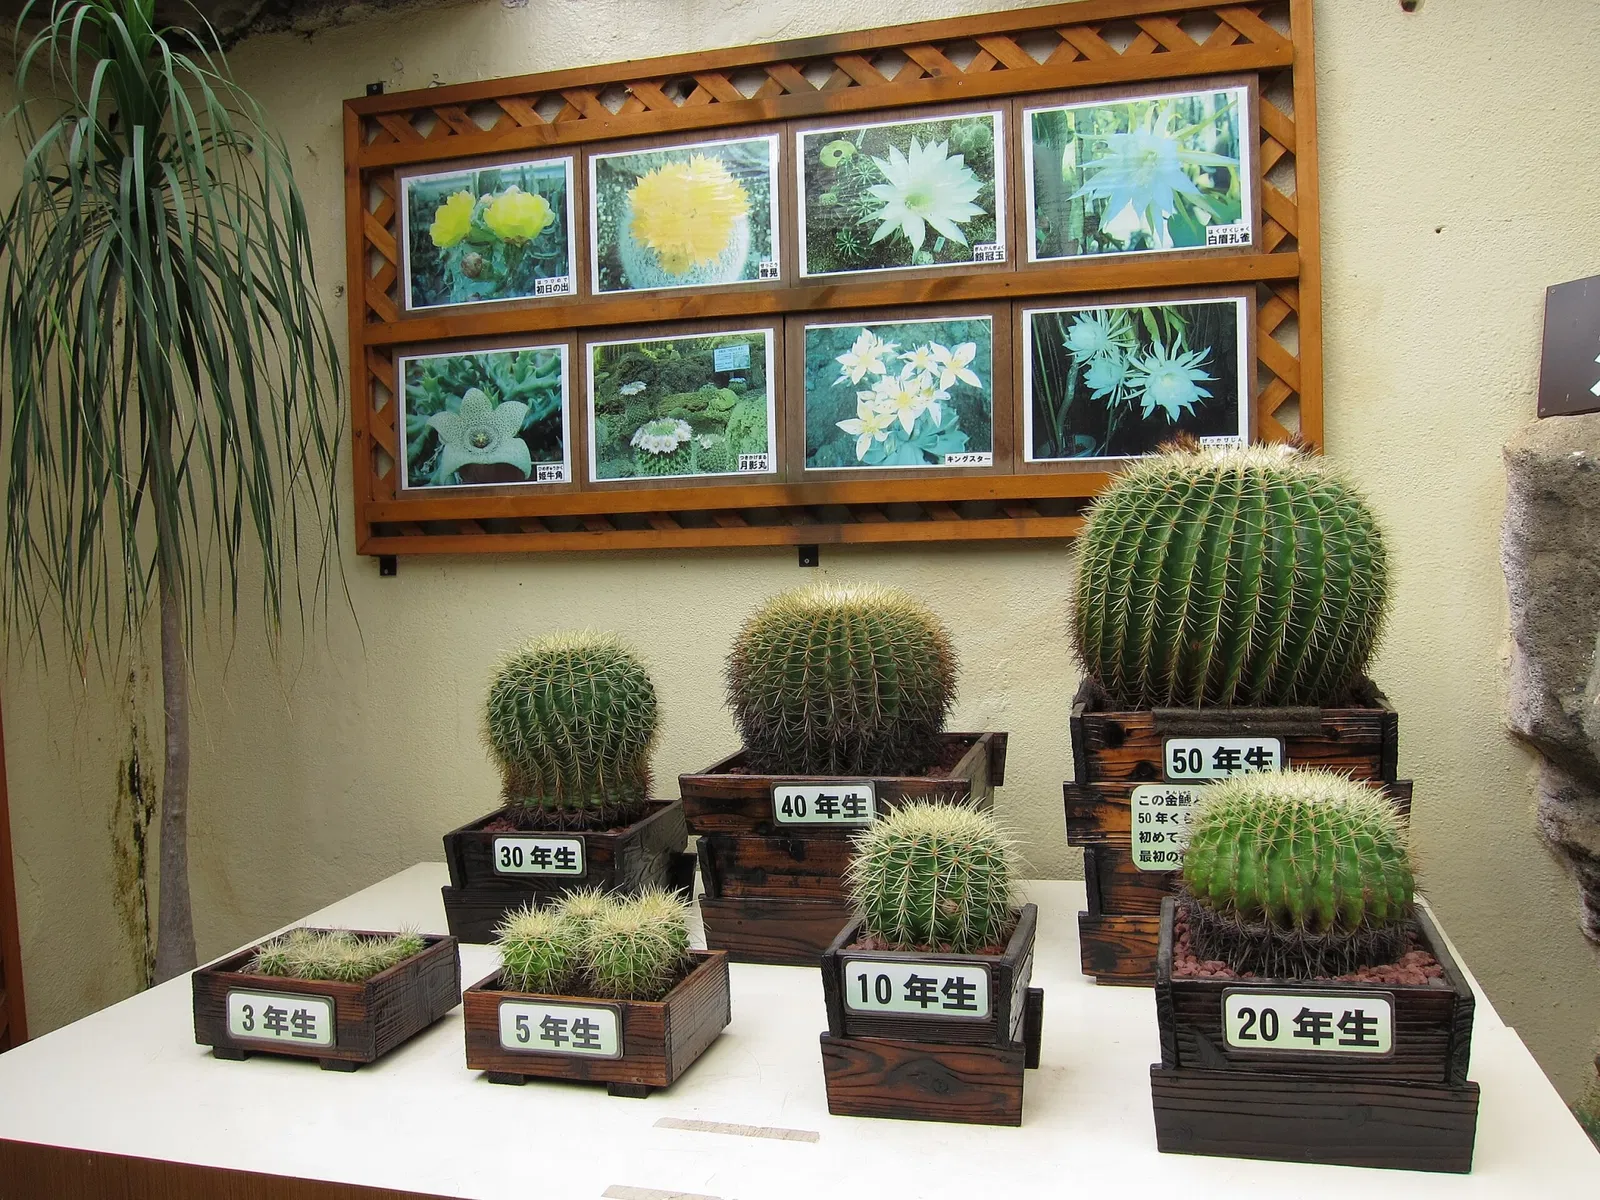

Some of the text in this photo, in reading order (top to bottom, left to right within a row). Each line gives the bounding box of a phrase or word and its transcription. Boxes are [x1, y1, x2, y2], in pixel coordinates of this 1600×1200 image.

[1208, 233, 1250, 245] 白眉孔雀
[975, 251, 1004, 261] 銀冠玉
[536, 283, 569, 294] 初日の出
[740, 460, 767, 470] 月影丸
[947, 455, 991, 464] キングスター
[538, 471, 563, 481] 姫牛角
[1173, 746, 1273, 775] 50 年生
[781, 793, 868, 819] 40 年生
[1138, 812, 1152, 824] 50
[500, 845, 577, 870] 30 年生
[857, 973, 978, 1011] 10 年生
[242, 1004, 317, 1039] 3 年生
[1237, 1007, 1380, 1047] 20 年生
[515, 1014, 602, 1050] 5 年生
